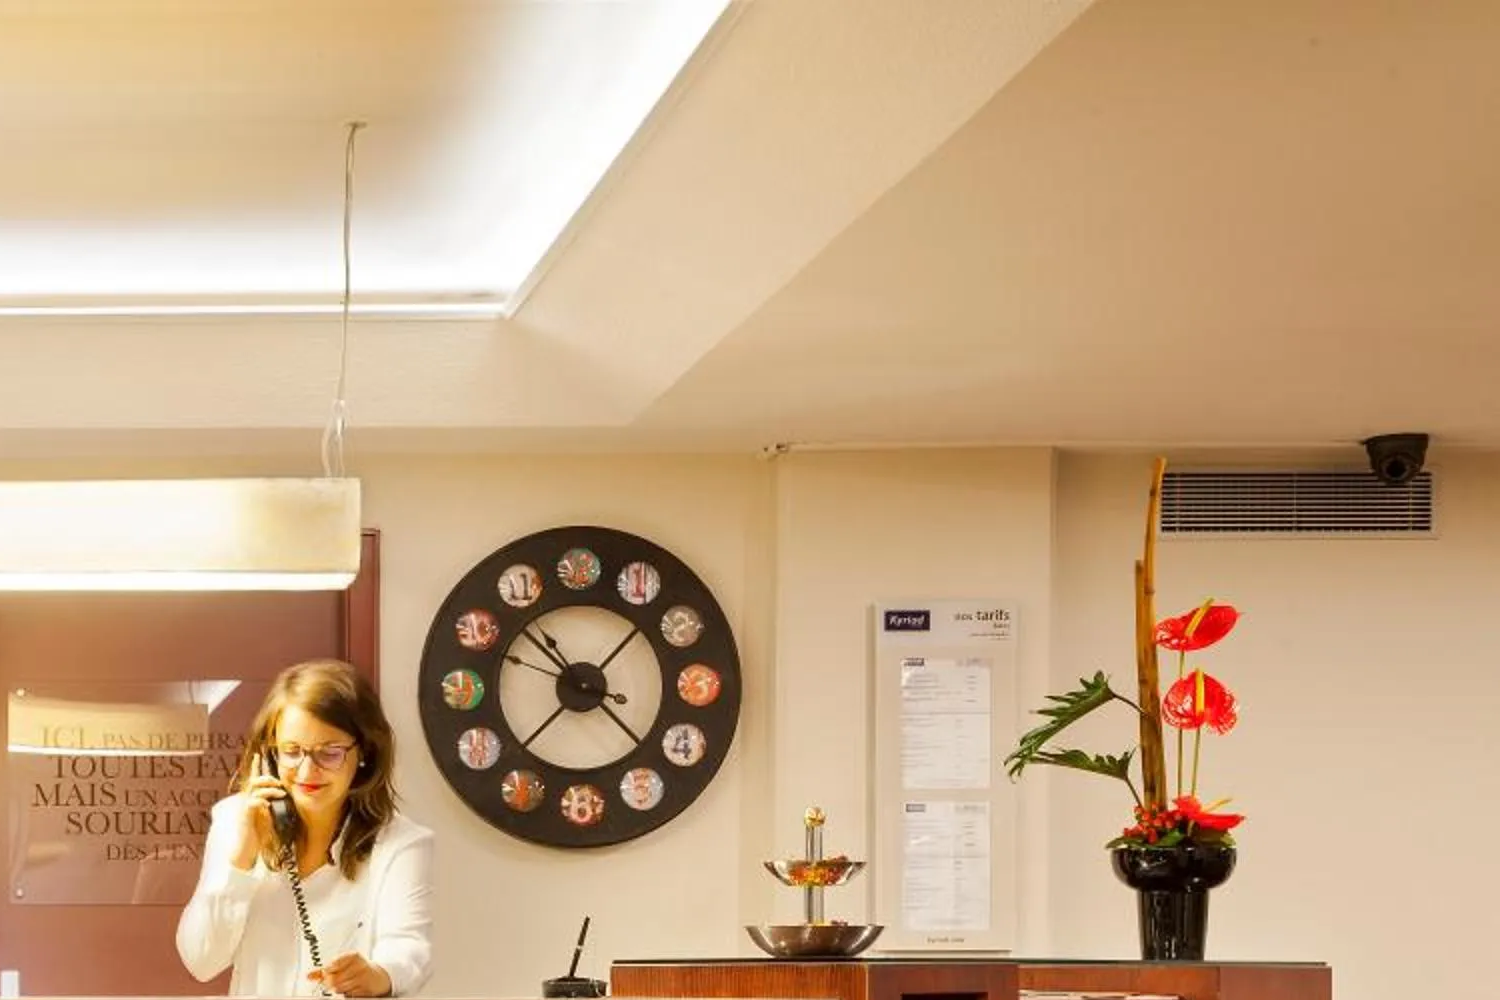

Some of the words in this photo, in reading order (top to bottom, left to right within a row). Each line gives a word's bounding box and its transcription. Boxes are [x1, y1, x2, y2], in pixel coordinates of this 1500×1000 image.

[977, 609, 1010, 621] tarifs
[148, 732, 181, 750] DE
[186, 732, 246, 750] PHRA
[49, 755, 185, 780] TOUTES
[31, 782, 117, 807] MAIS
[124, 789, 157, 807] UN
[152, 843, 202, 861] L'EN
